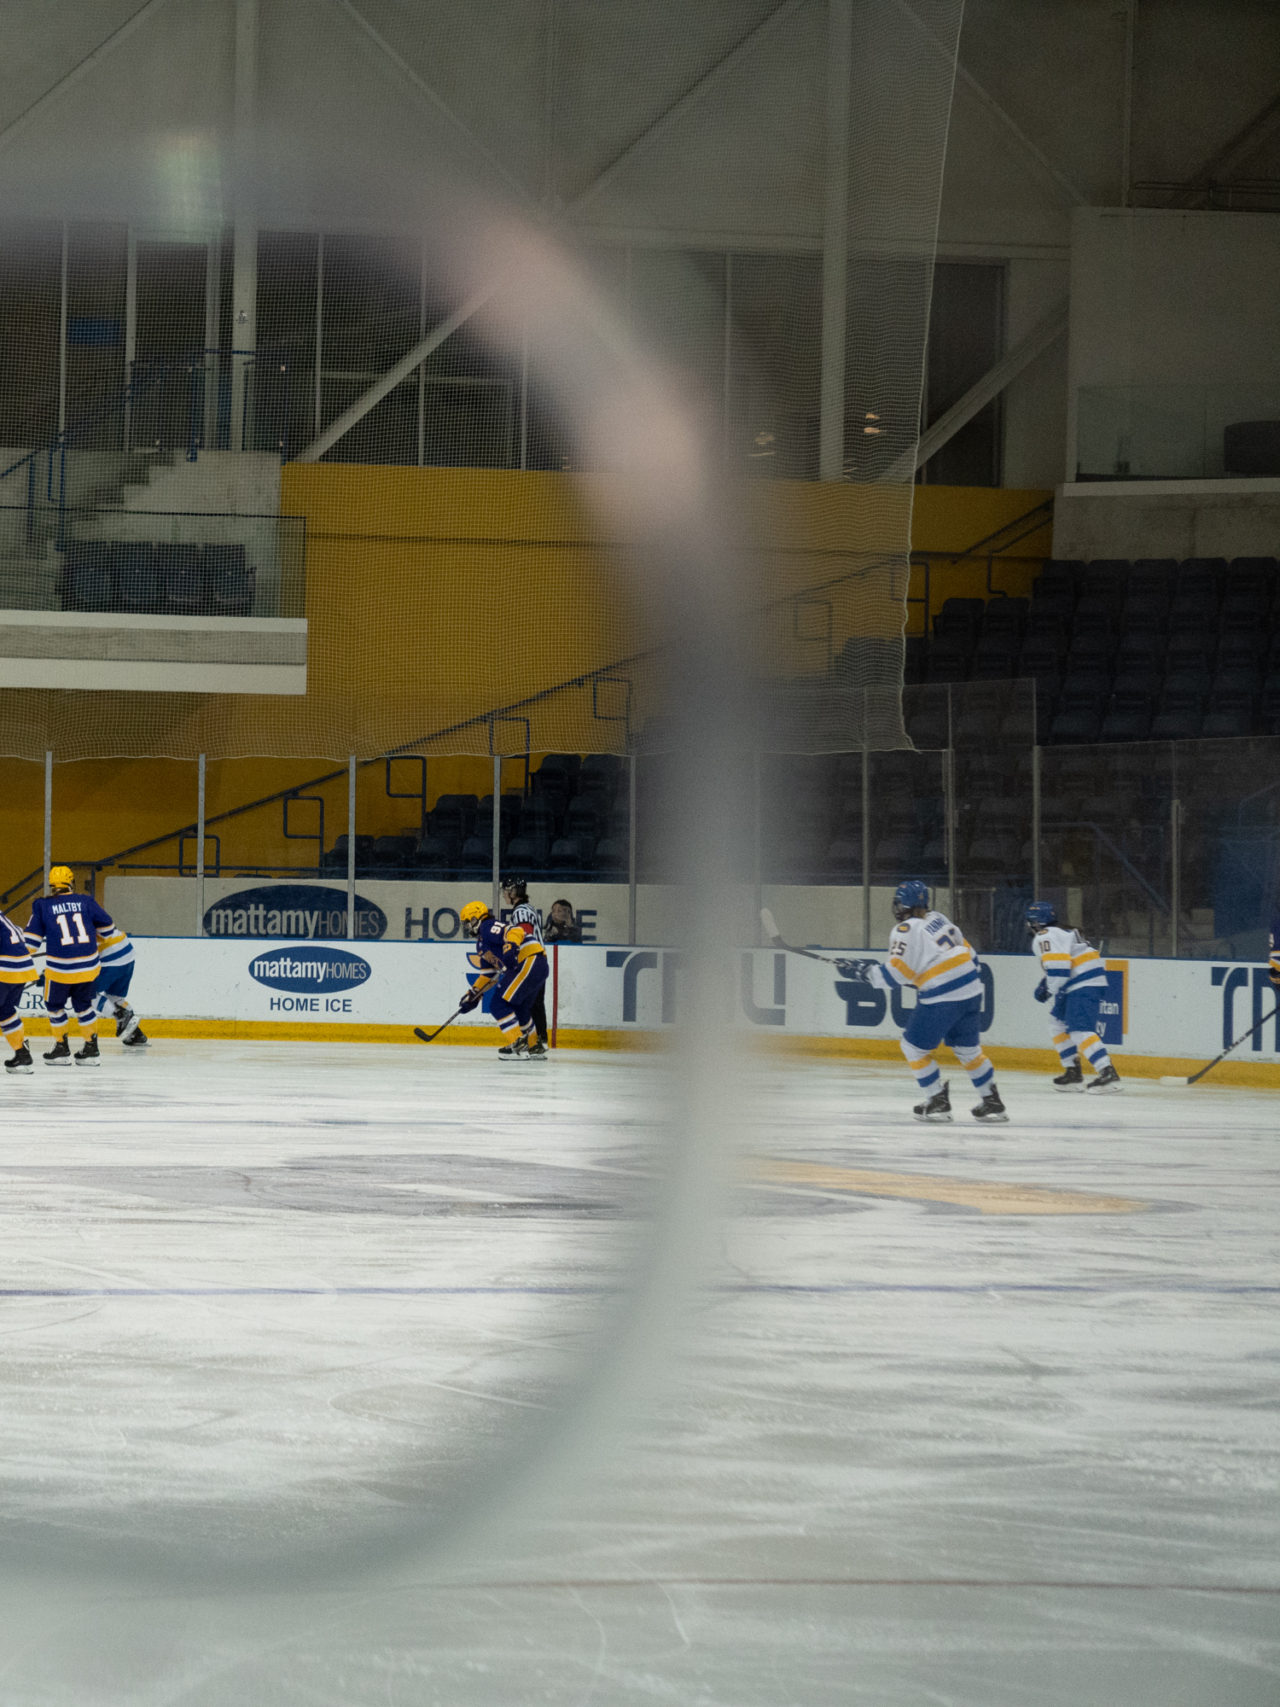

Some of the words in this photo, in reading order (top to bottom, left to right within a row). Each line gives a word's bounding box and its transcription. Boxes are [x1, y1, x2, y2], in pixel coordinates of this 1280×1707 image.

[52, 902, 82, 915] MALTBY
[56, 912, 91, 946] 11
[269, 997, 320, 1012] HOME
[324, 998, 353, 1013] ICE
